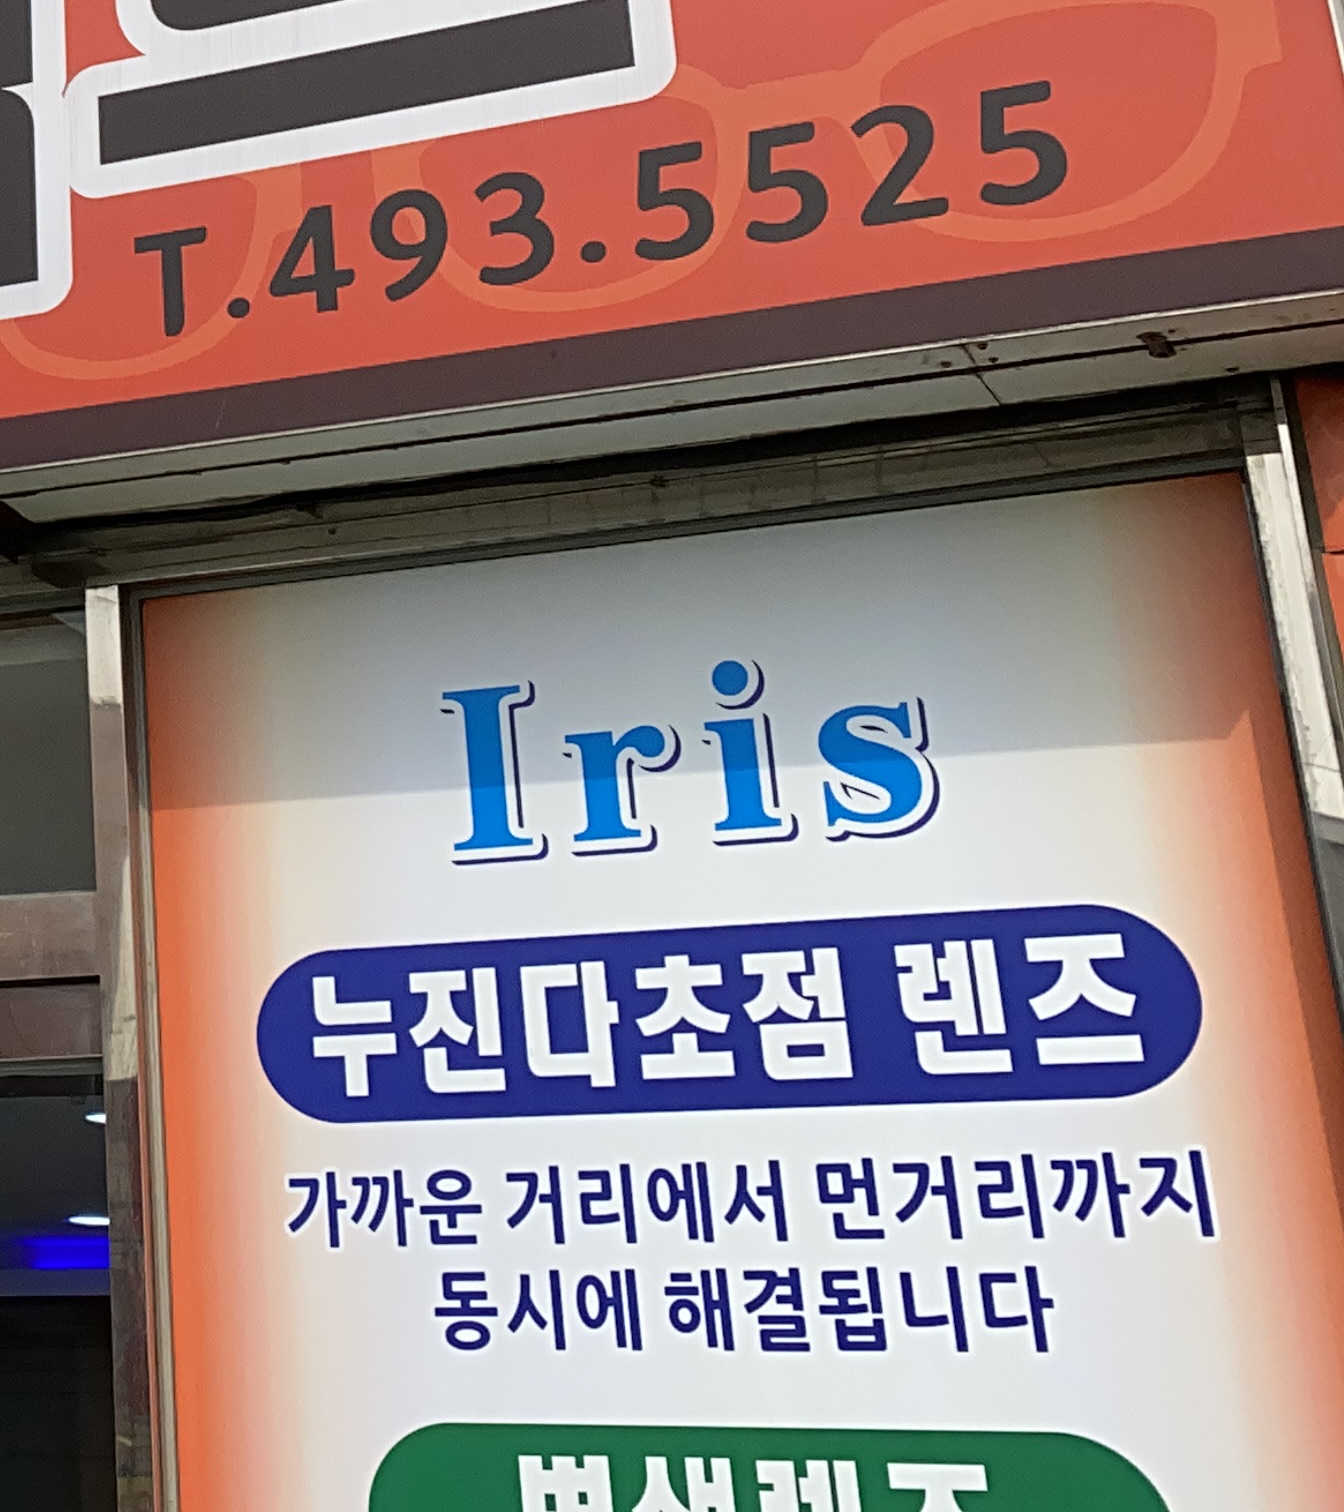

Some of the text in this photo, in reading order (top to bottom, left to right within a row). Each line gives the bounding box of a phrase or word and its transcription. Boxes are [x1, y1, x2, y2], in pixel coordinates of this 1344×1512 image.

[133, 79, 1070, 338] T.493.5525
[439, 658, 942, 866] Iris
[311, 932, 1147, 1099] 누진다초점 렌즈
[285, 1147, 1219, 1250] 가까운 거리에서 먼거리까지
[431, 1263, 1057, 1355] 동시에 해결됩니다
